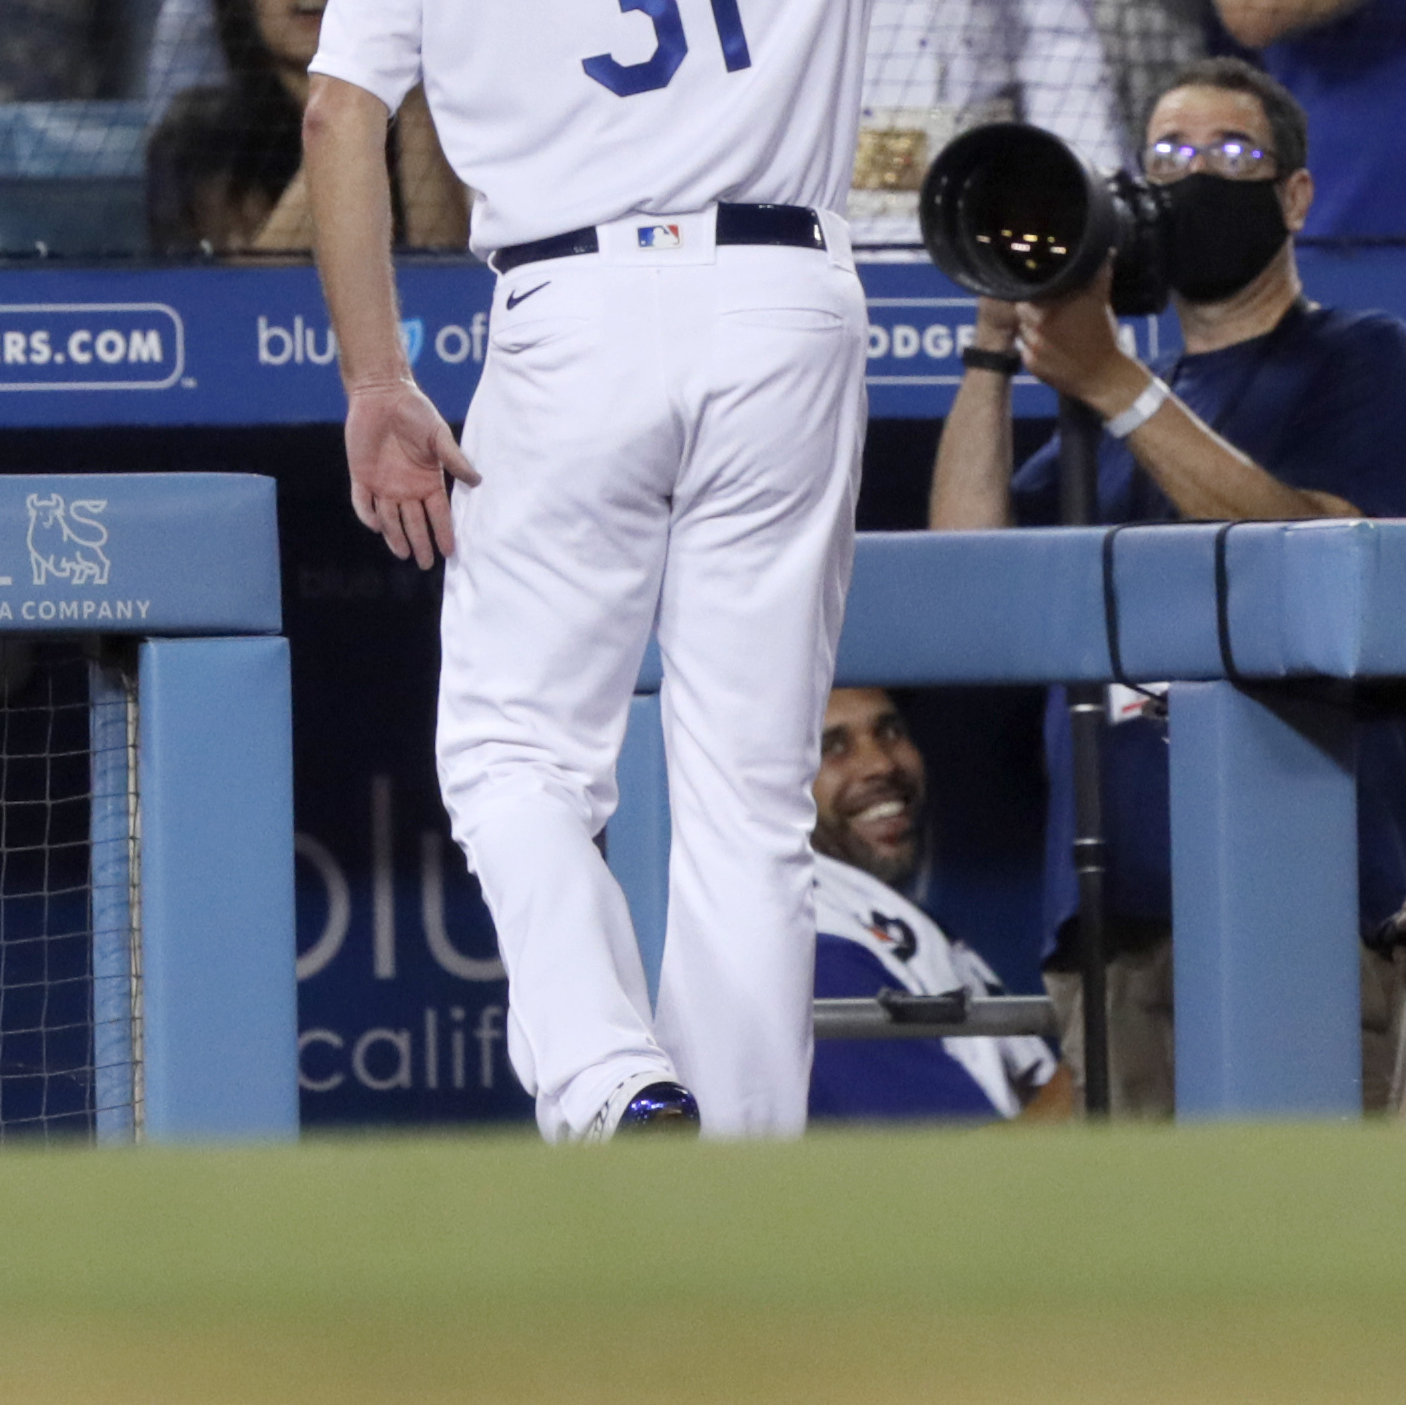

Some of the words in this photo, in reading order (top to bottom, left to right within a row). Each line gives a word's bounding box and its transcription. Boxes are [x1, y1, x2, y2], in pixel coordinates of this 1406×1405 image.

[257, 316, 337, 366] blu
[435, 314, 488, 364] of
[21, 599, 152, 620] COMPANY
[297, 1005, 504, 1093] calif
